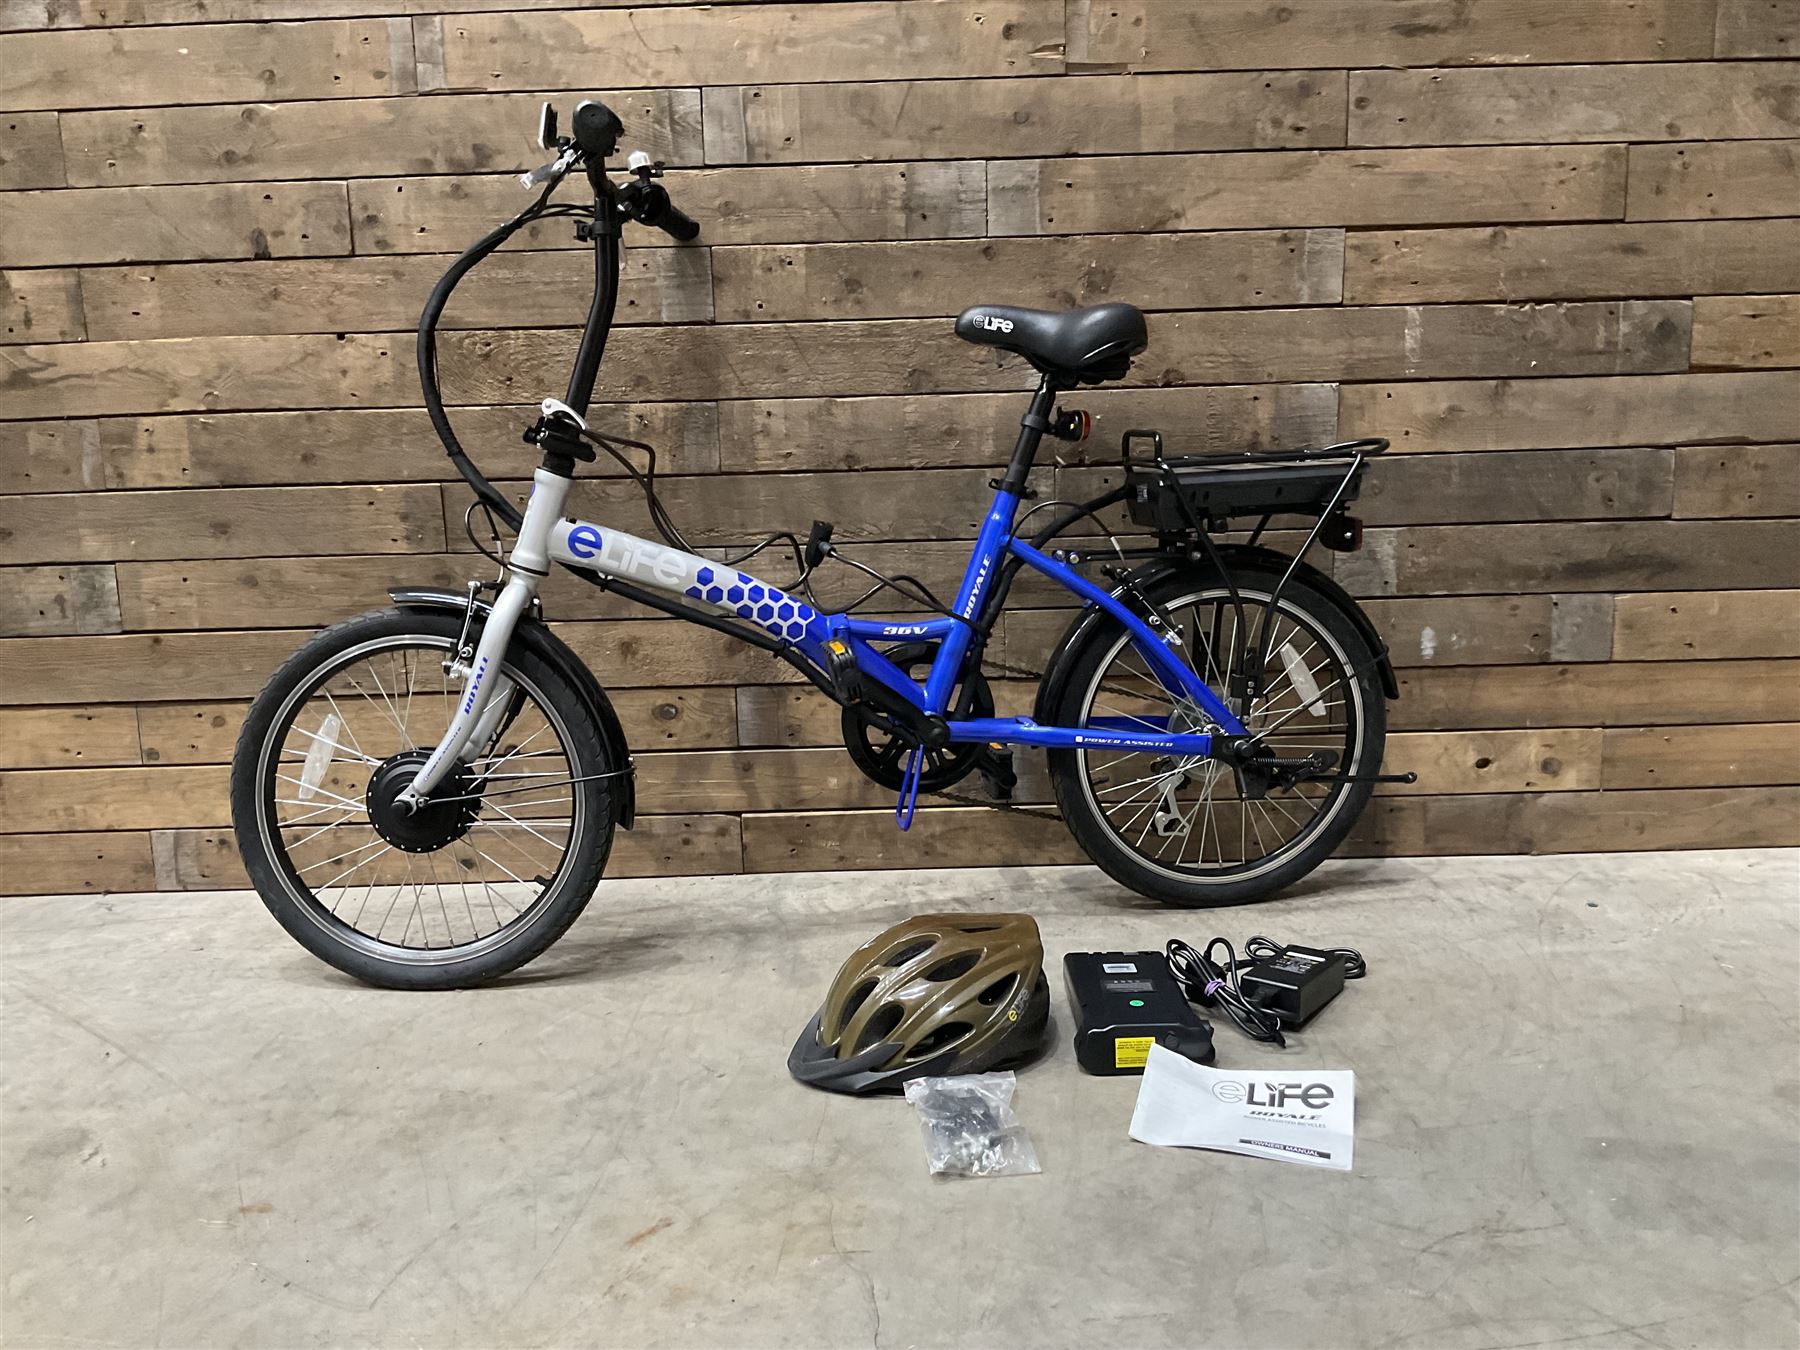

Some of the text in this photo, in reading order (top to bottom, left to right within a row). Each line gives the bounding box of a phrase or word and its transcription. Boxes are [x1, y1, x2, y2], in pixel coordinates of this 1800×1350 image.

[963, 553, 991, 620] ROYALE
[883, 626, 929, 635] 36V
[1251, 1140, 1320, 1157] OWNERS MANUAL
